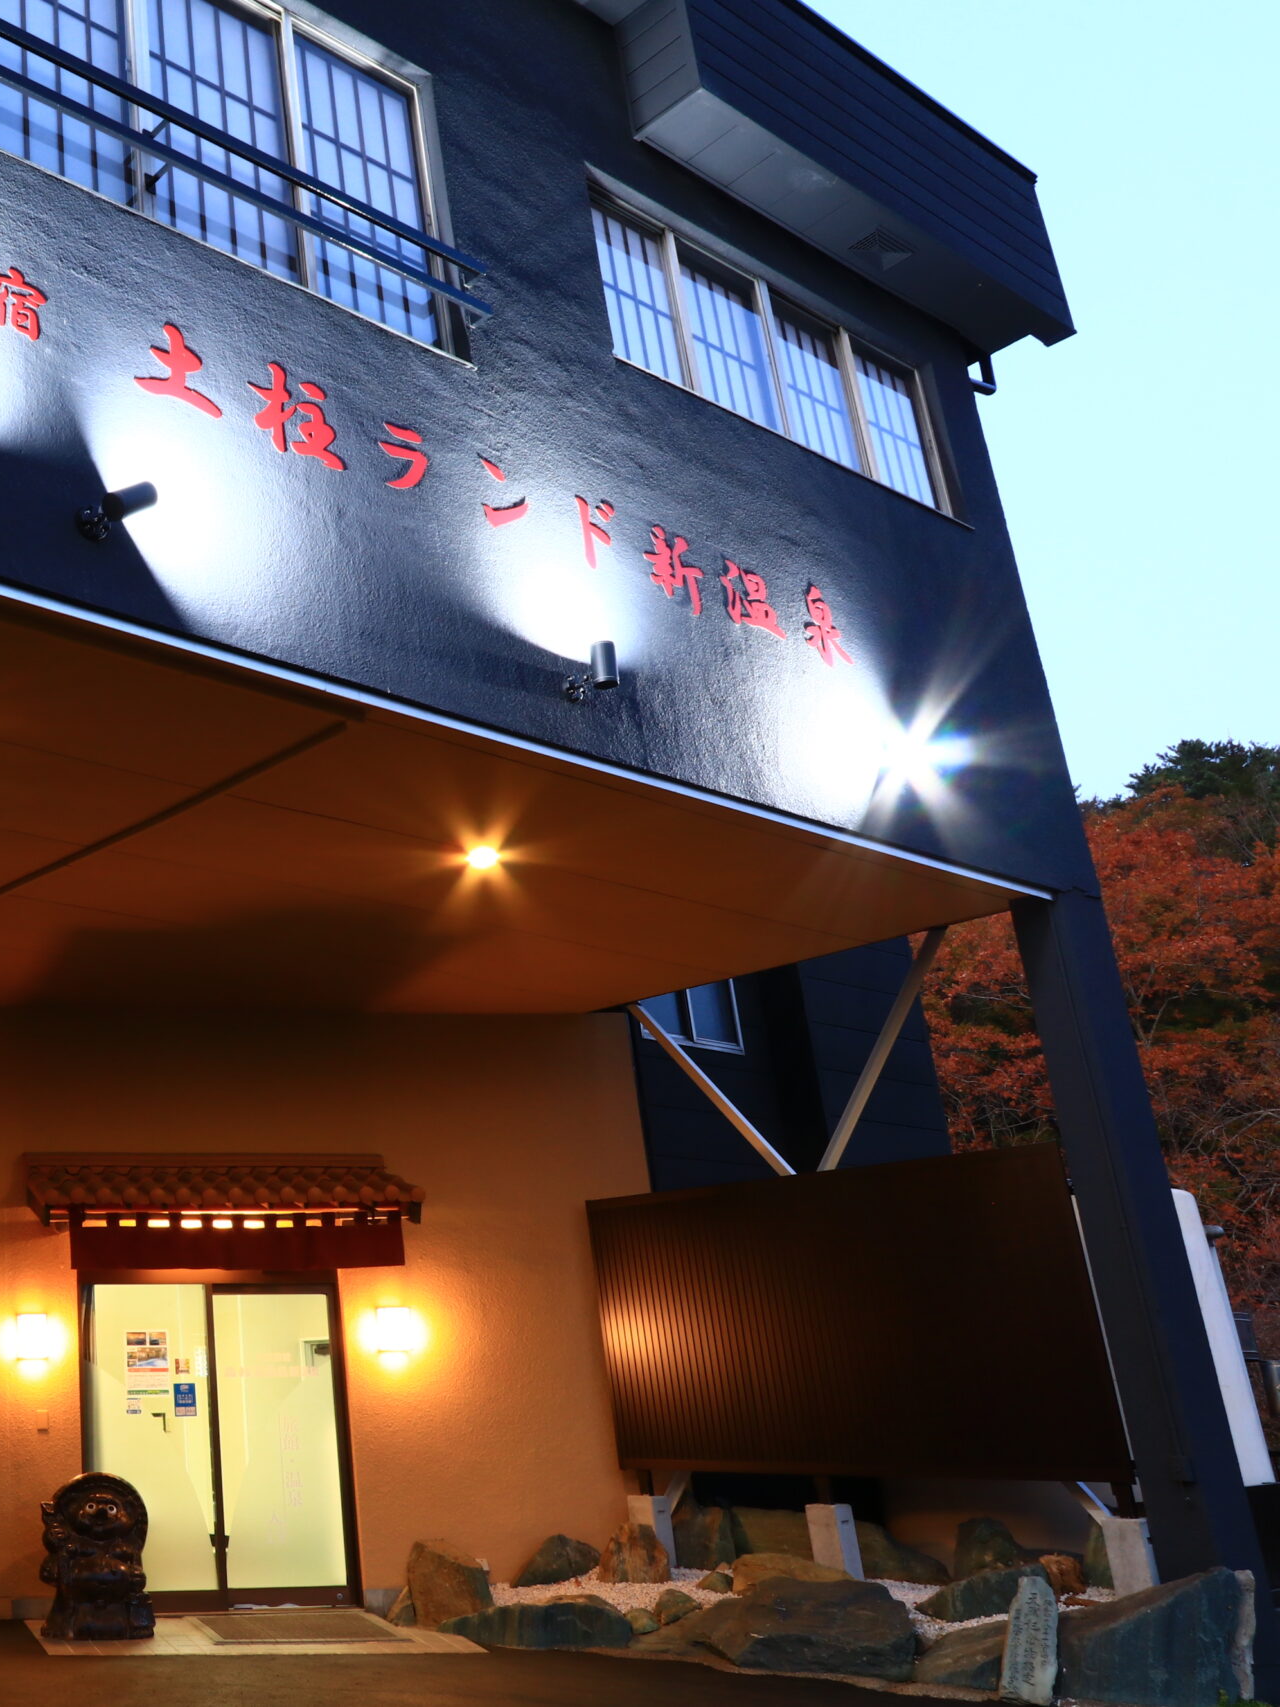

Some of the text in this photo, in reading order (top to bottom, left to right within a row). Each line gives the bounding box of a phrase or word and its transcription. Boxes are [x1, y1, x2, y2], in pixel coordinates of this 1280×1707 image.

[134, 322, 855, 667] 土柱ランド新温泉
